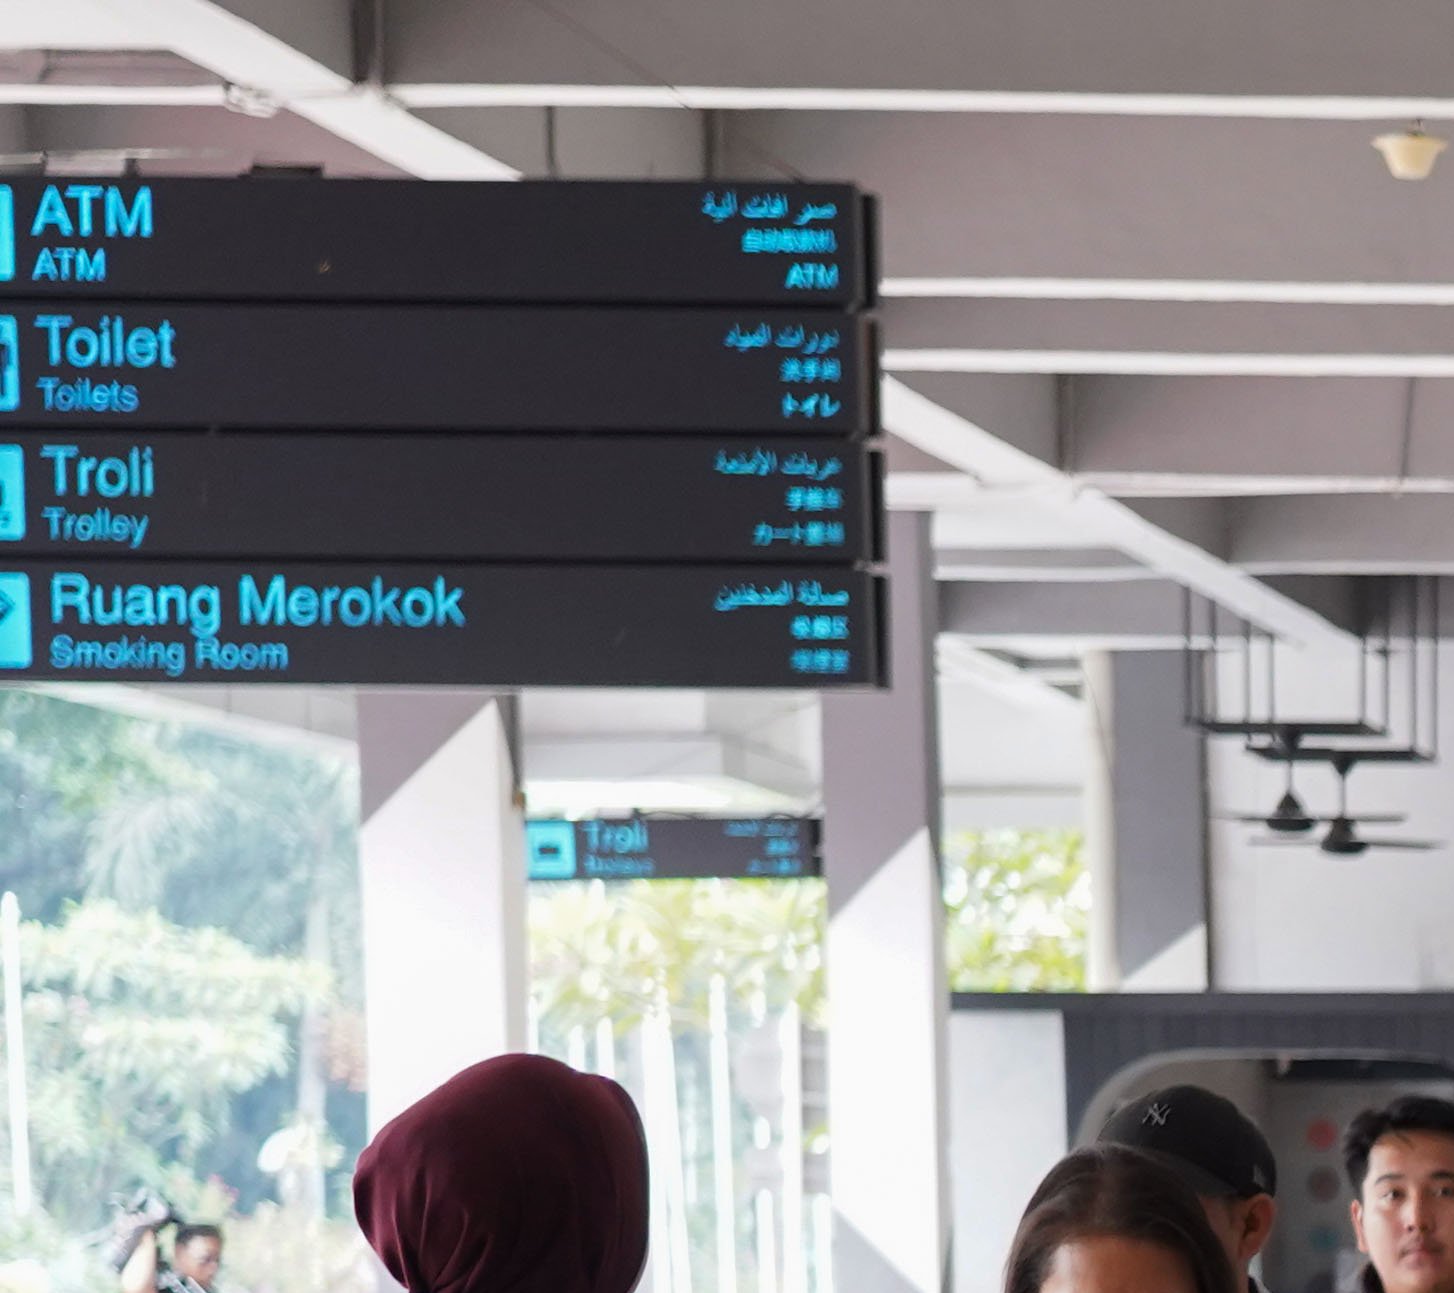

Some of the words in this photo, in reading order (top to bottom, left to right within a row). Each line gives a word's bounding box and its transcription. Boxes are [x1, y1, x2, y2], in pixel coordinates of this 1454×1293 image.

[30, 183, 154, 239] ATM
[32, 247, 107, 282] ATM
[784, 261, 840, 289] ATM
[33, 314, 177, 369] Toilet
[35, 374, 139, 413] Toilets
[40, 443, 156, 499] Troli
[42, 504, 149, 549] Trolley
[50, 571, 223, 635] Ruang
[238, 573, 466, 629] Merokok
[50, 635, 185, 678] Smoking
[194, 636, 290, 671] Room
[582, 820, 649, 854] Troli
